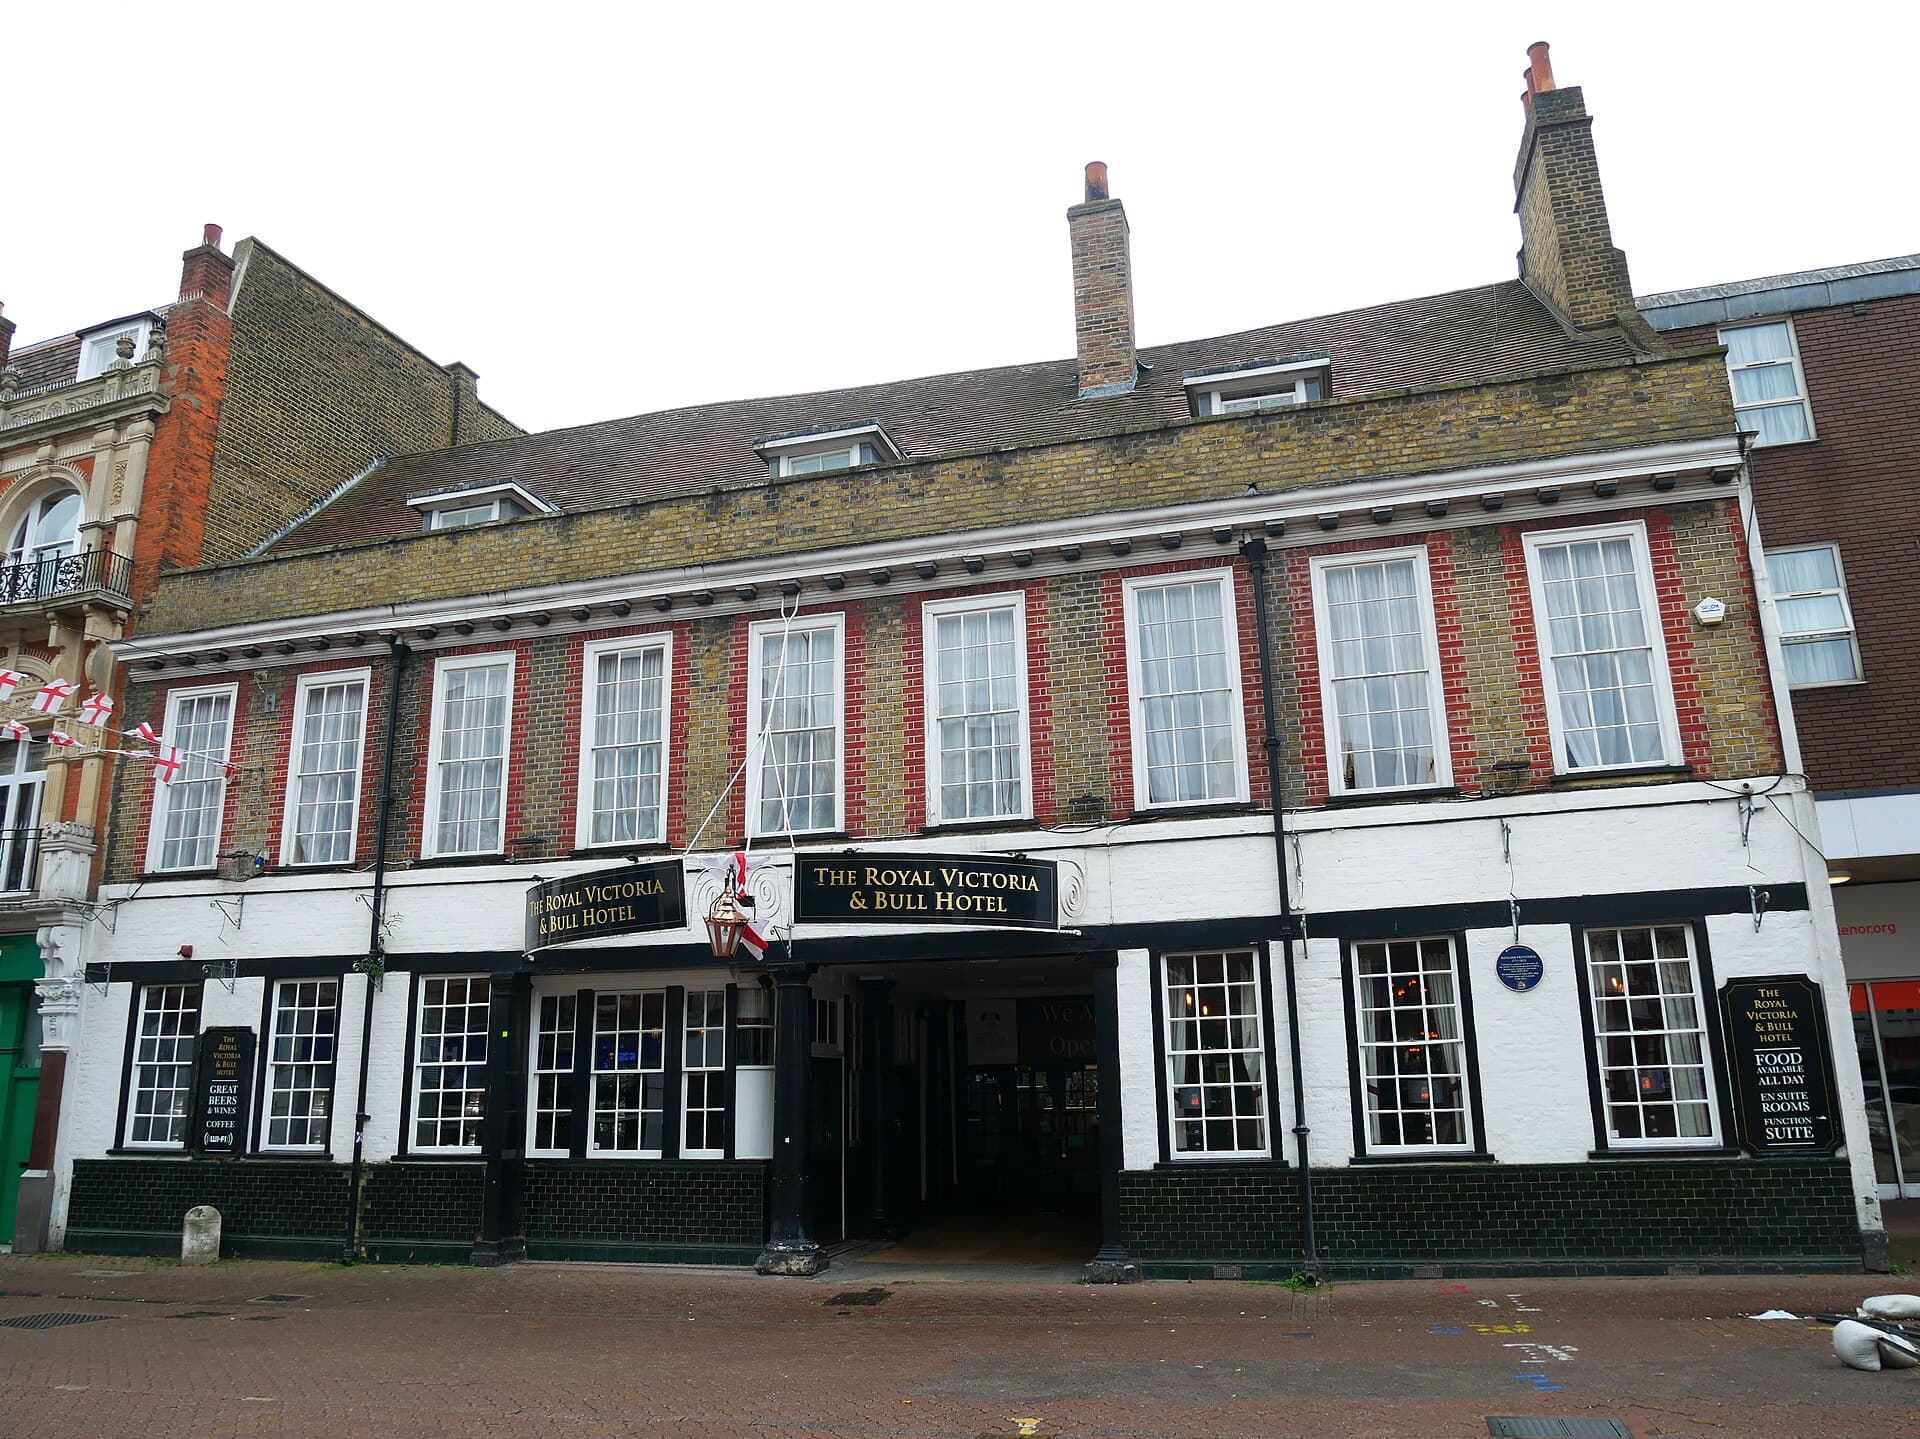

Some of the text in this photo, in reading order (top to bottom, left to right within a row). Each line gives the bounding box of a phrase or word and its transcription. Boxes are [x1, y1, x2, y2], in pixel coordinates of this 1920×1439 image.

[814, 867, 1040, 892] THE ROYAL VICTORIA
[530, 879, 665, 917] THE ROYAL VICTORIA
[849, 890, 1007, 913] & BULL HOTEL
[539, 905, 636, 935] & BULL HOTEL
[1757, 988, 1781, 998] THE
[1753, 999, 1788, 1009] ROYAL
[1746, 1010, 1798, 1020] VICTORIA
[1754, 1022, 1794, 1032] & BULL
[1760, 1033, 1792, 1042] HOTEL
[1754, 1052, 1803, 1066] FOOD
[1757, 1065, 1805, 1074] AVAILABLE
[1758, 1075, 1805, 1086] ALL DAY
[209, 1084, 239, 1094] GREAT
[208, 1095, 238, 1105] BEERS
[1760, 1091, 1809, 1101] EN SUITE
[207, 1106, 237, 1114] & WINES
[1762, 1101, 1810, 1113] ROOMS
[206, 1120, 236, 1128] COFFEE
[1763, 1117, 1812, 1126] FUNCTION
[1765, 1126, 1815, 1140] SUITE
